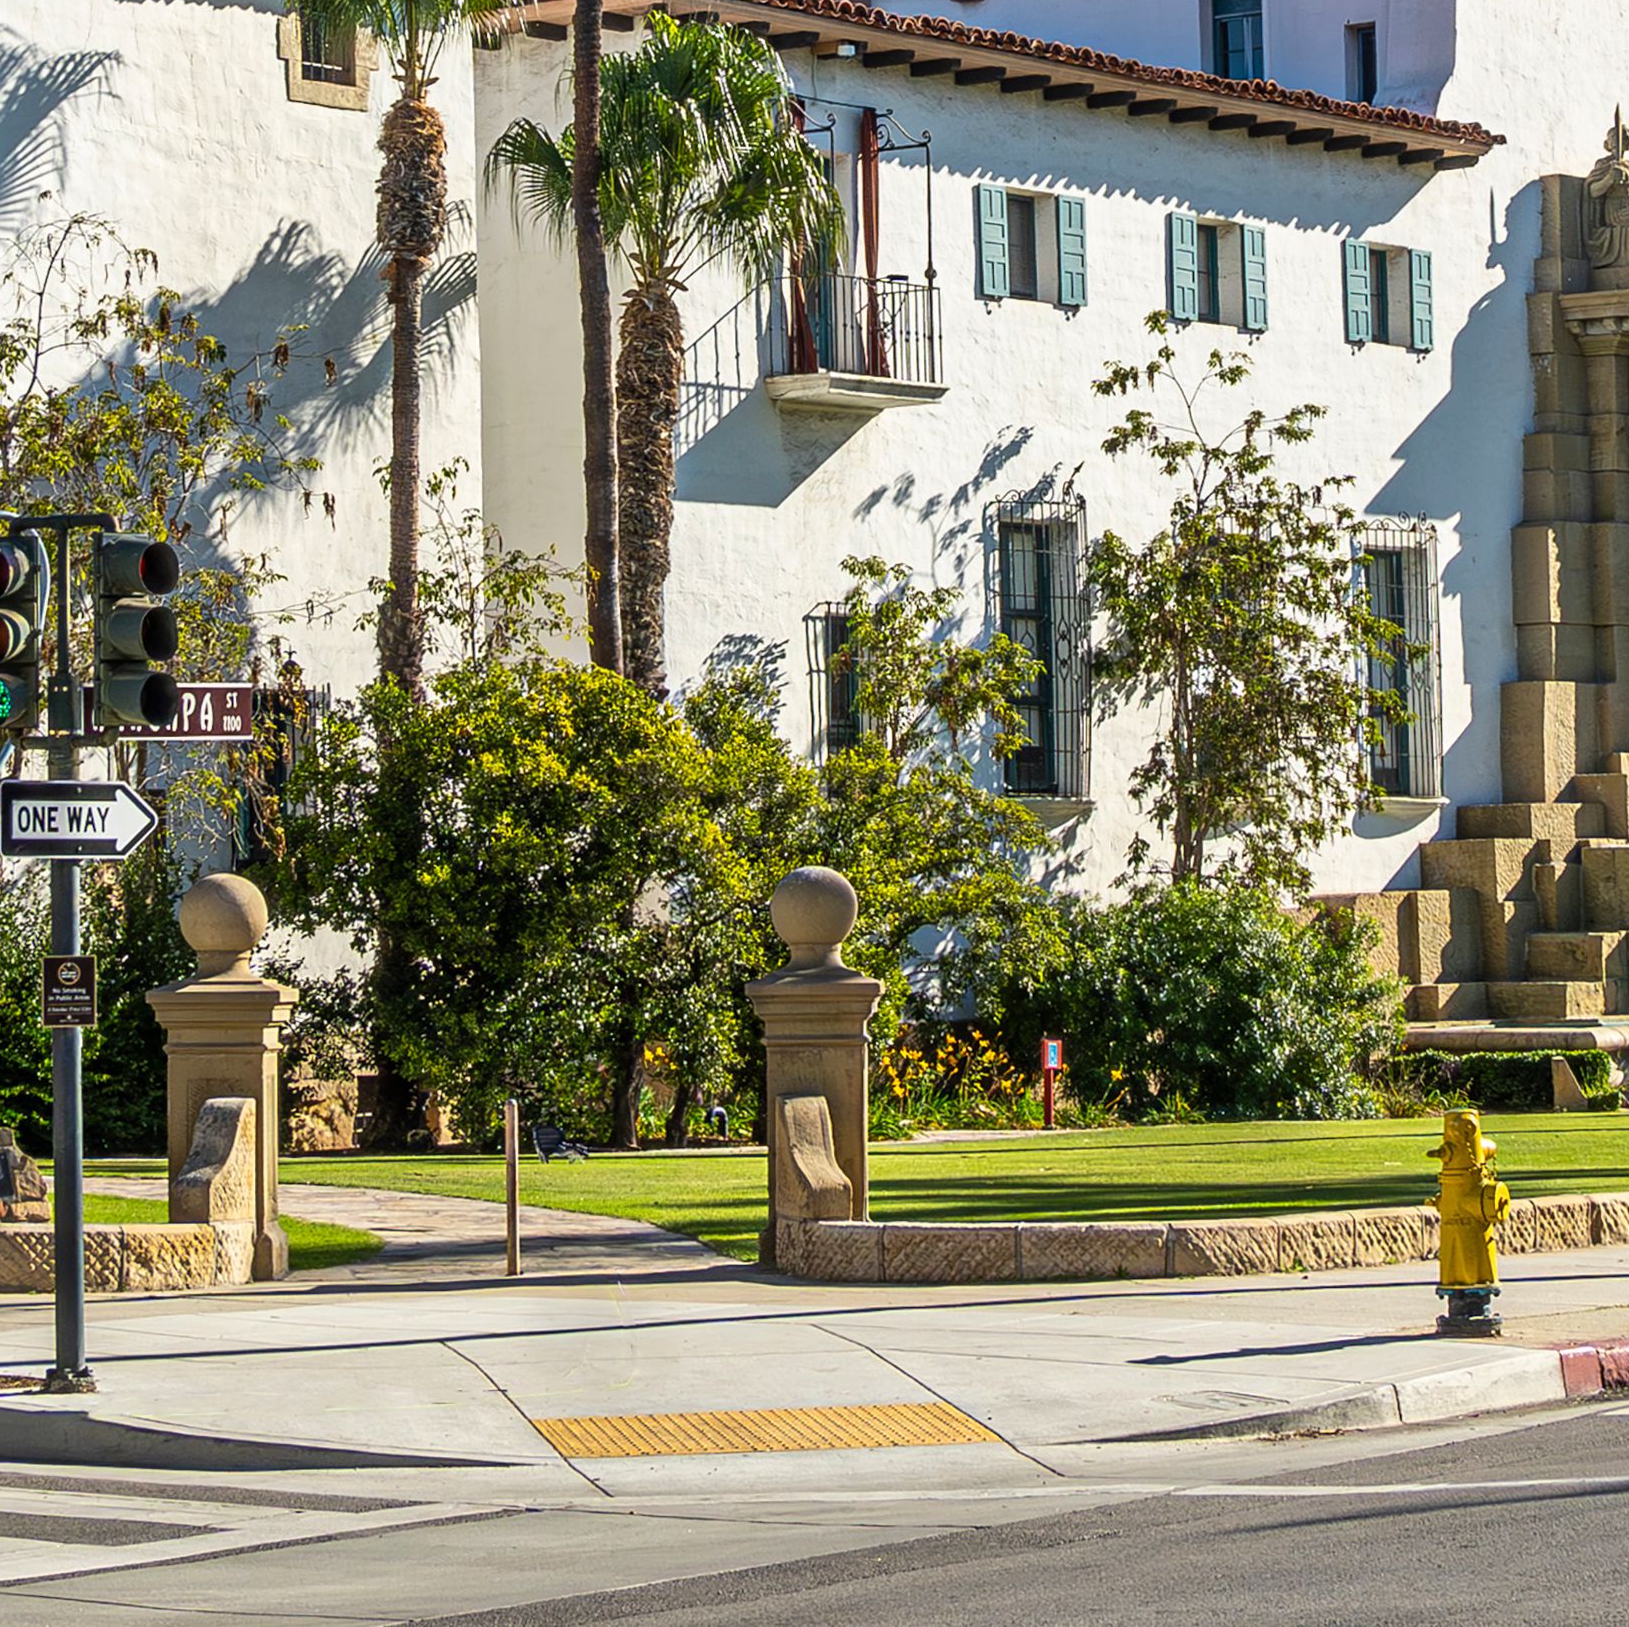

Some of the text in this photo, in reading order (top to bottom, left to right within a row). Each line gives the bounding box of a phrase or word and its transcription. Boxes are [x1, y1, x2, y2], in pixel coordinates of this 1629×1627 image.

[226, 692, 238, 709] ST
[18, 806, 109, 833] ONE WAY
